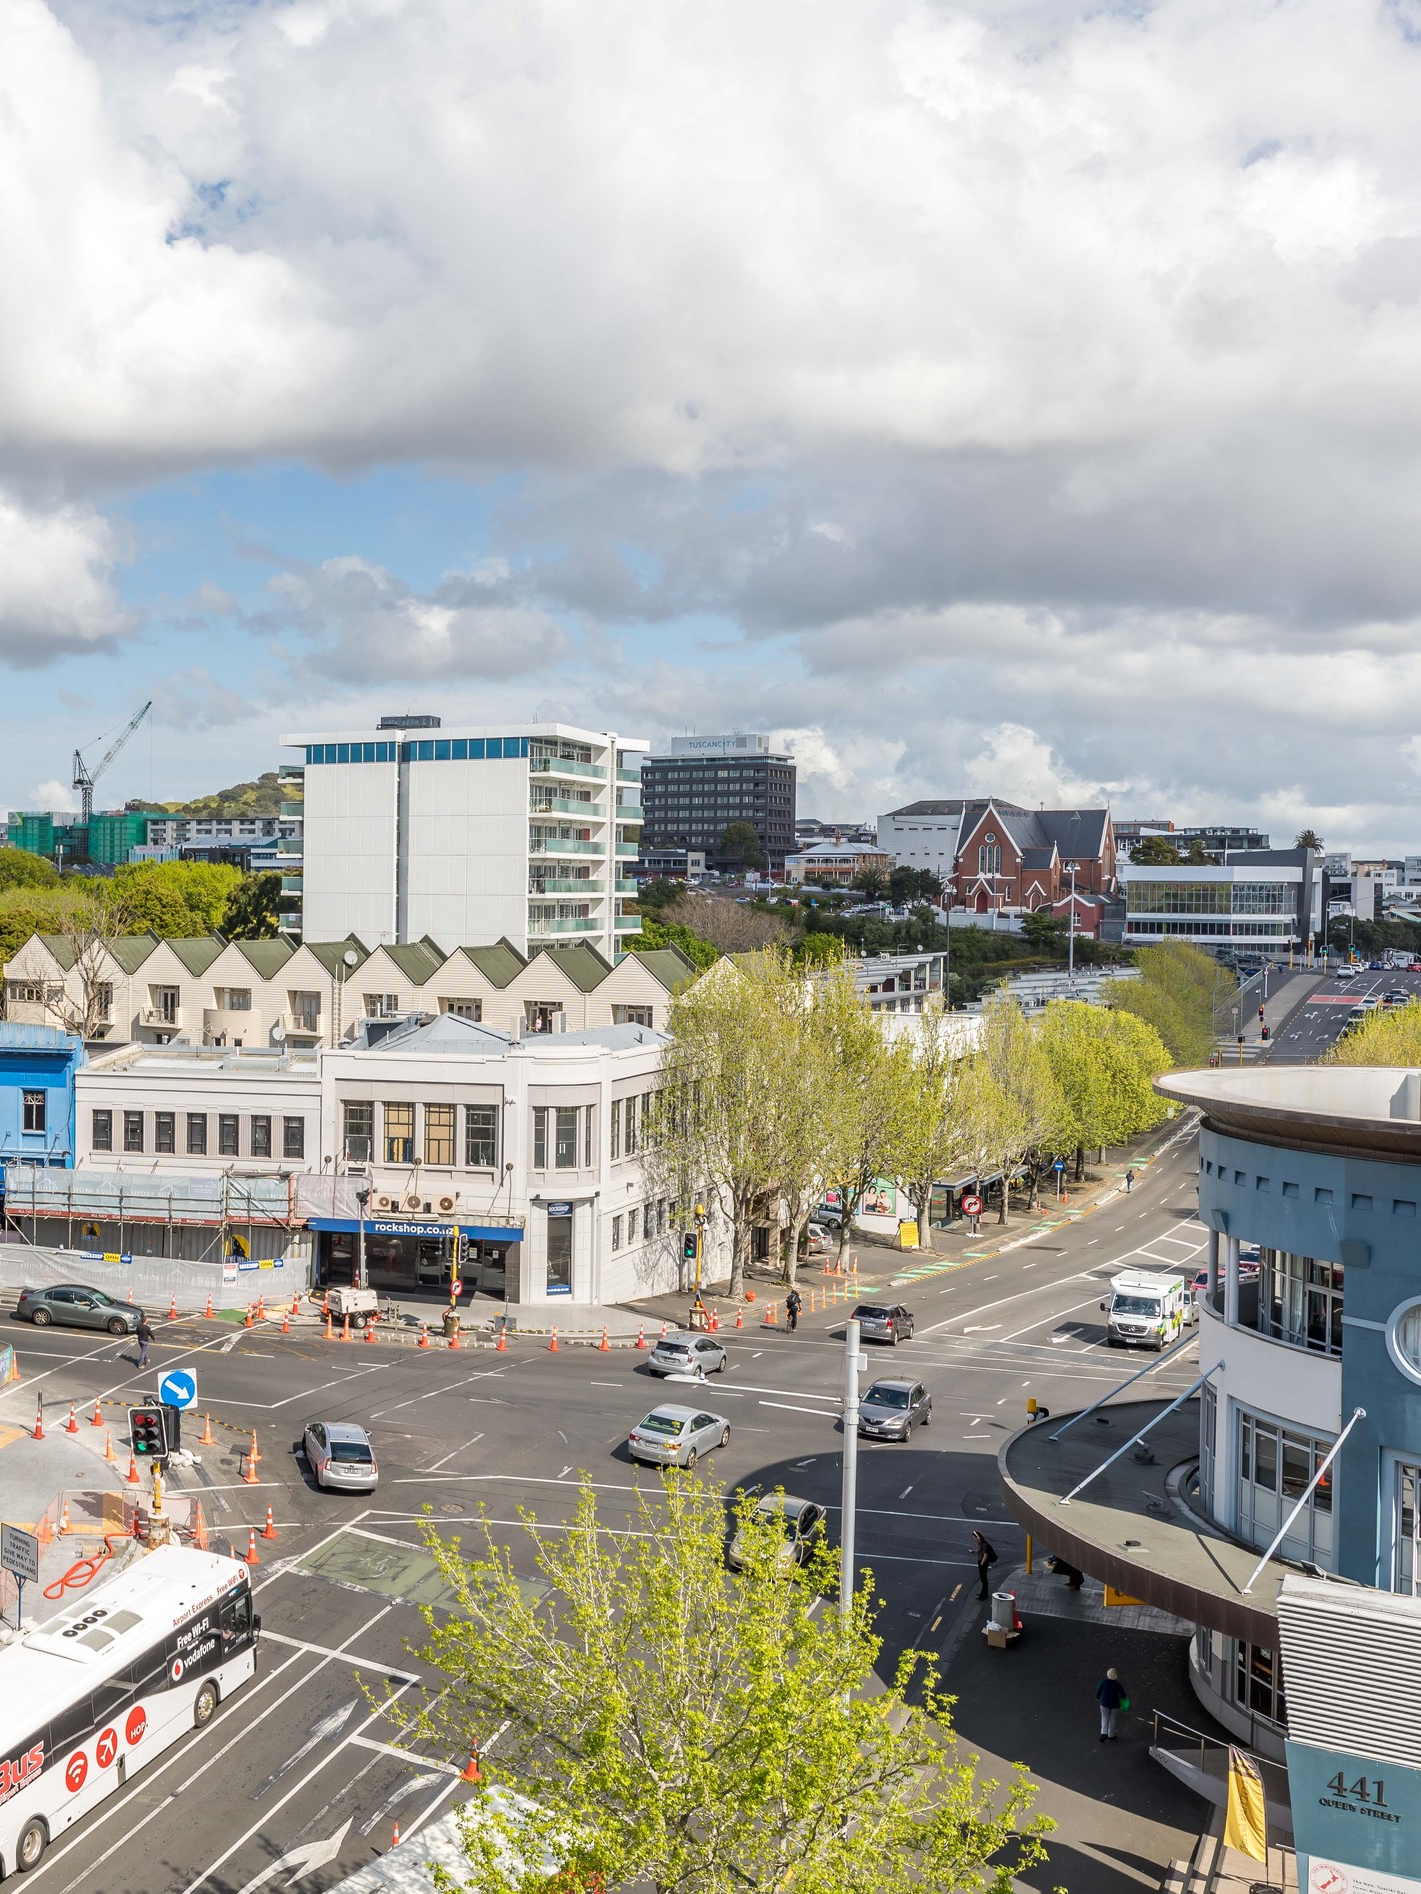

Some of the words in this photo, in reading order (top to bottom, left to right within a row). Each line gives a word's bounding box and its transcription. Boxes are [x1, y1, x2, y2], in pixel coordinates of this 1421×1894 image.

[9, 1533, 31, 1547] TURNING
[9, 1541, 30, 1556] TRAFFIC
[2, 1555, 37, 1576] PEDESTRIANS
[3, 1547, 16, 1558] GIVE
[16, 1553, 28, 1562] WAY
[28, 1558, 36, 1567] TO
[172, 1609, 191, 1627] Airport
[191, 1594, 214, 1614] Express
[216, 1584, 229, 1595] Free
[176, 1631, 193, 1650] Free
[183, 1638, 216, 1668] vodafone
[1326, 1771, 1389, 1807] 441
[1318, 1797, 1358, 1813] QUEEN
[1360, 1806, 1402, 1823] STREET
